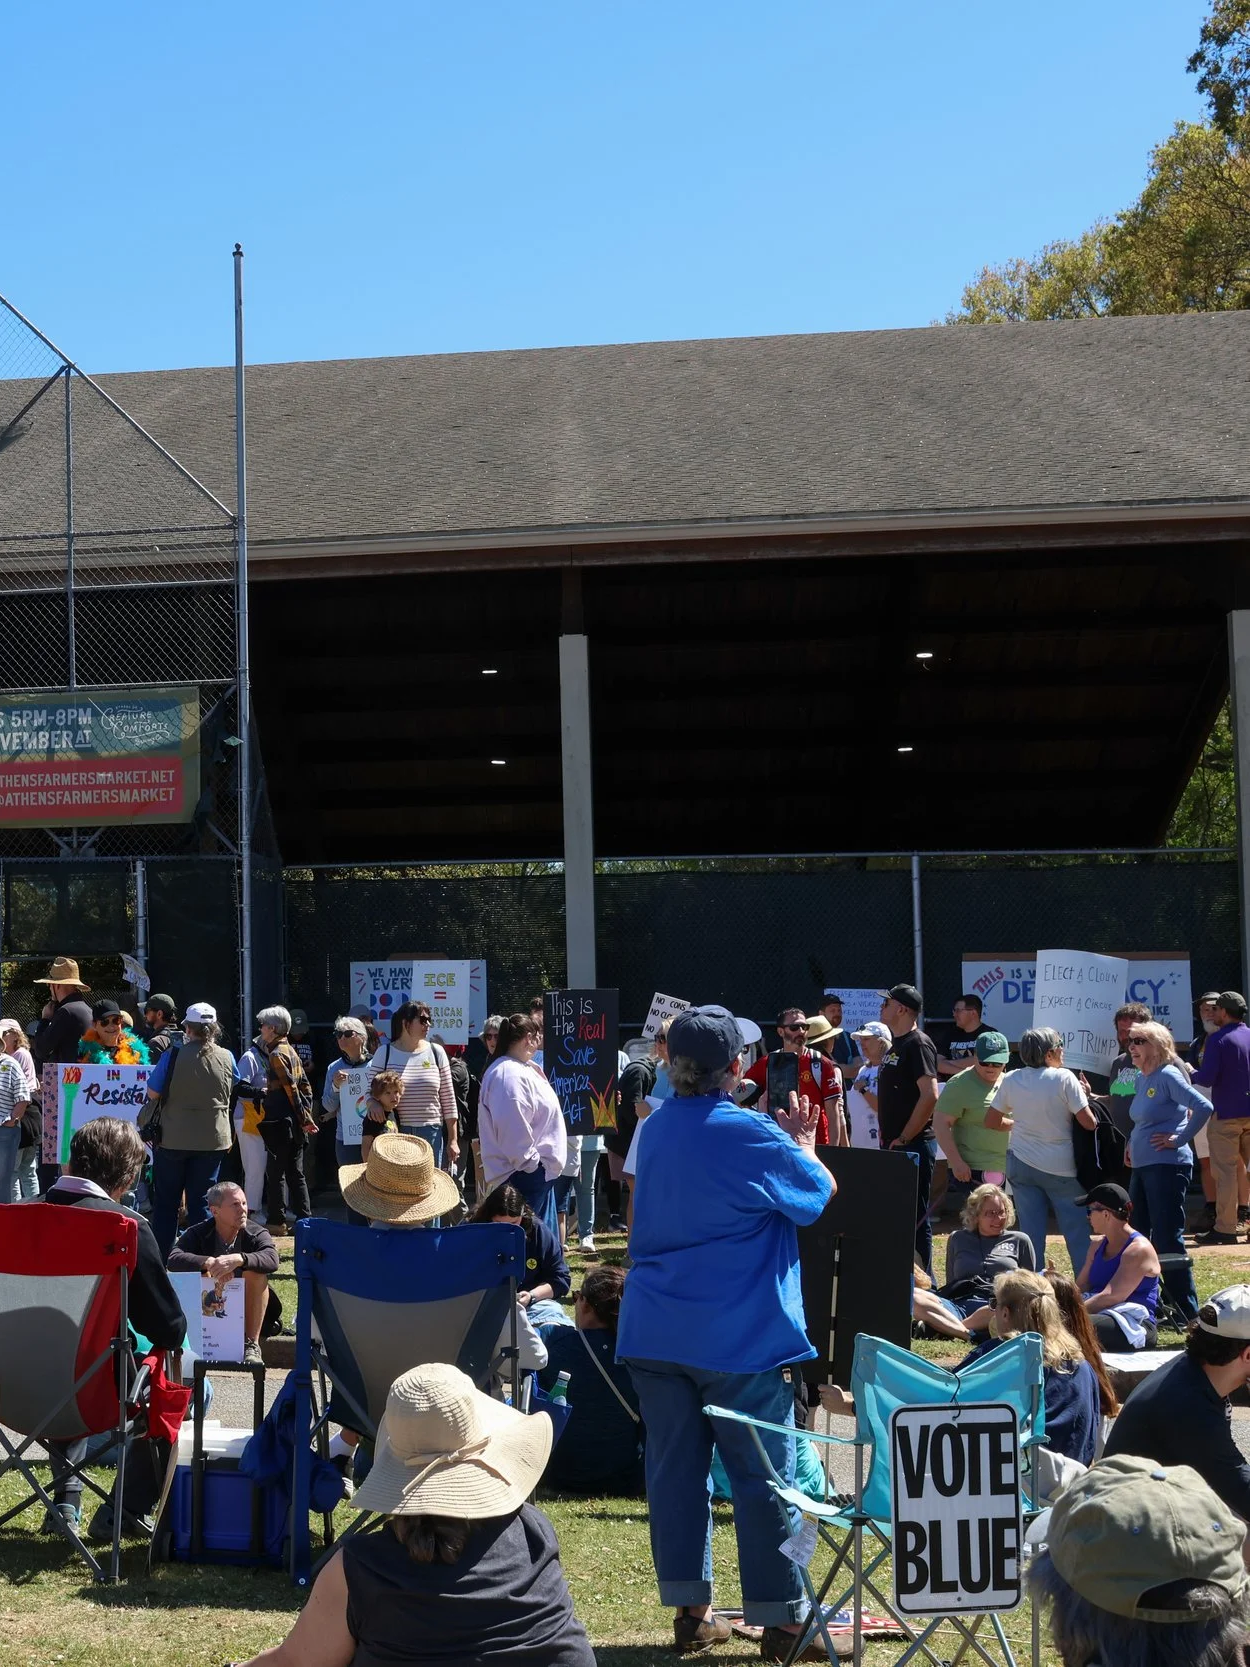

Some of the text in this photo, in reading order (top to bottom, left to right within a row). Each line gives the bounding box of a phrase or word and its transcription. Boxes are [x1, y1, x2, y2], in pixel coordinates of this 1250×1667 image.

[11, 707, 92, 727] 5PM-8PM
[75, 730, 91, 744] AT
[367, 967, 413, 978] WE HAV
[423, 973, 456, 987] ICE
[972, 966, 1005, 993] THIS
[1011, 968, 1022, 979] IS
[373, 978, 413, 991] EVER
[546, 991, 593, 1016] This is
[655, 996, 666, 1005] NO
[430, 1007, 463, 1017] ERICAN
[650, 1008, 660, 1017] NO
[1152, 1005, 1170, 1015] IKE
[430, 1018, 463, 1029] STAPO
[553, 1013, 605, 1041] the Real
[558, 1036, 597, 1066] Save
[1078, 1030, 1117, 1056] TRUMP
[106, 1069, 121, 1081] IN
[348, 1073, 361, 1085] NO
[550, 1066, 592, 1097] America
[83, 1082, 149, 1106] Resista
[561, 1095, 587, 1125] Act
[897, 1422, 1017, 1498] VOTE
[898, 1517, 1021, 1595] BLUE
